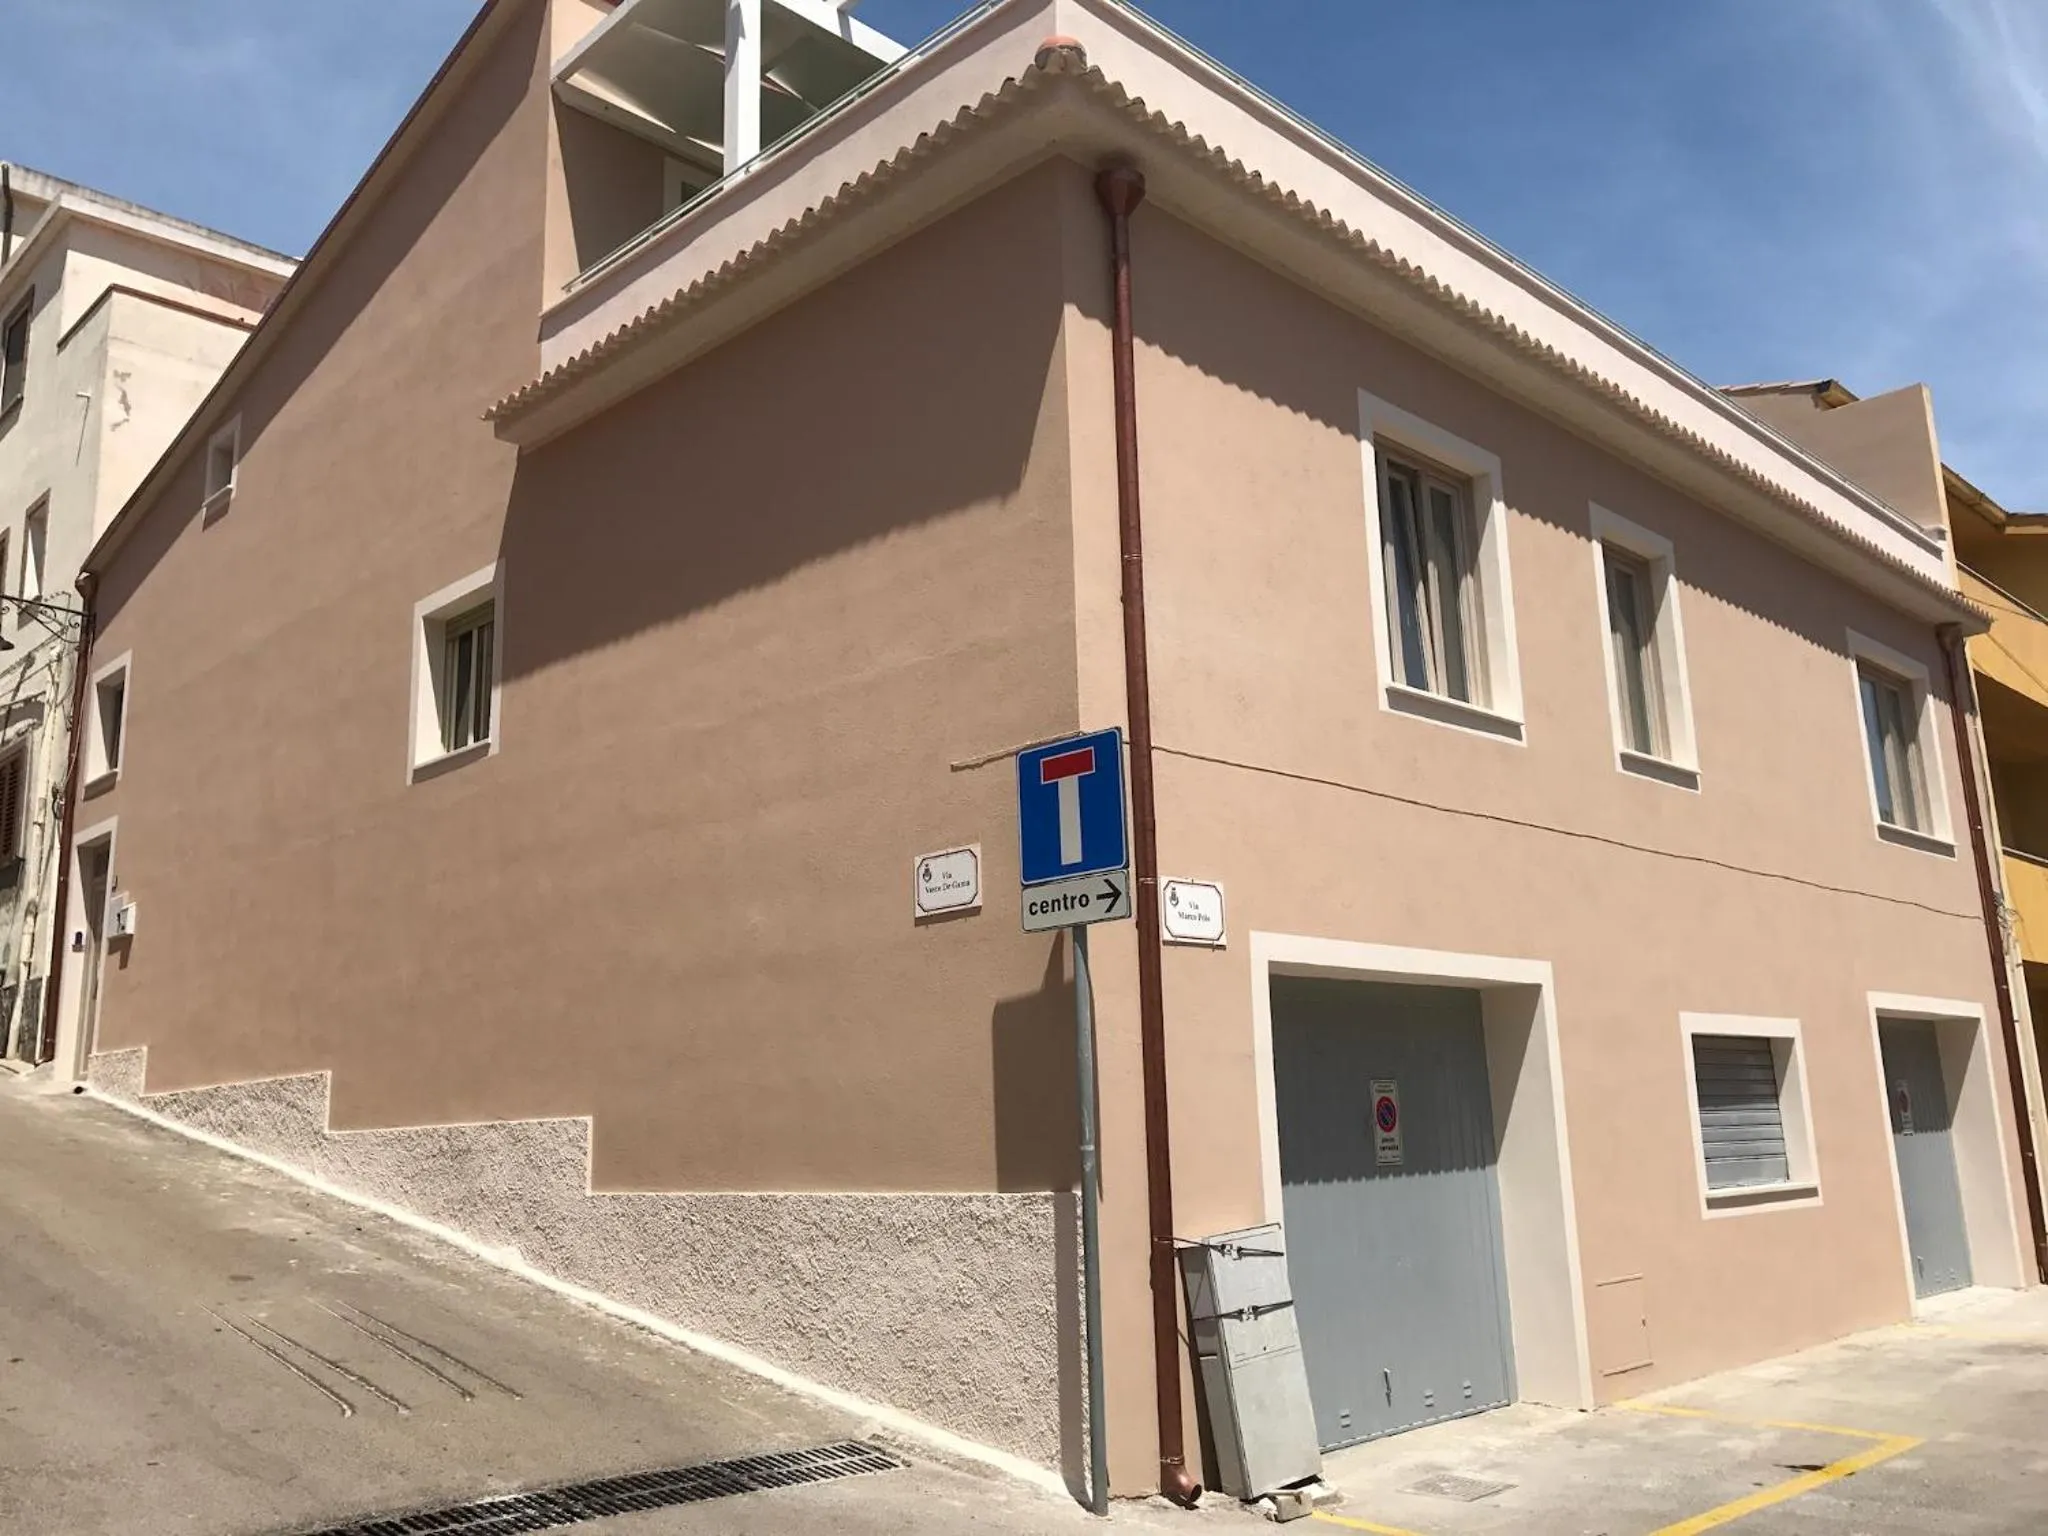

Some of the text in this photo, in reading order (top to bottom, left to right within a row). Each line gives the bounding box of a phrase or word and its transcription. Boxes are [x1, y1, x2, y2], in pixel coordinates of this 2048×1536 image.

[942, 871, 952, 879] Via
[1028, 893, 1090, 916] centro
[1189, 901, 1199, 910] Via
[1178, 911, 1197, 921] Marco
